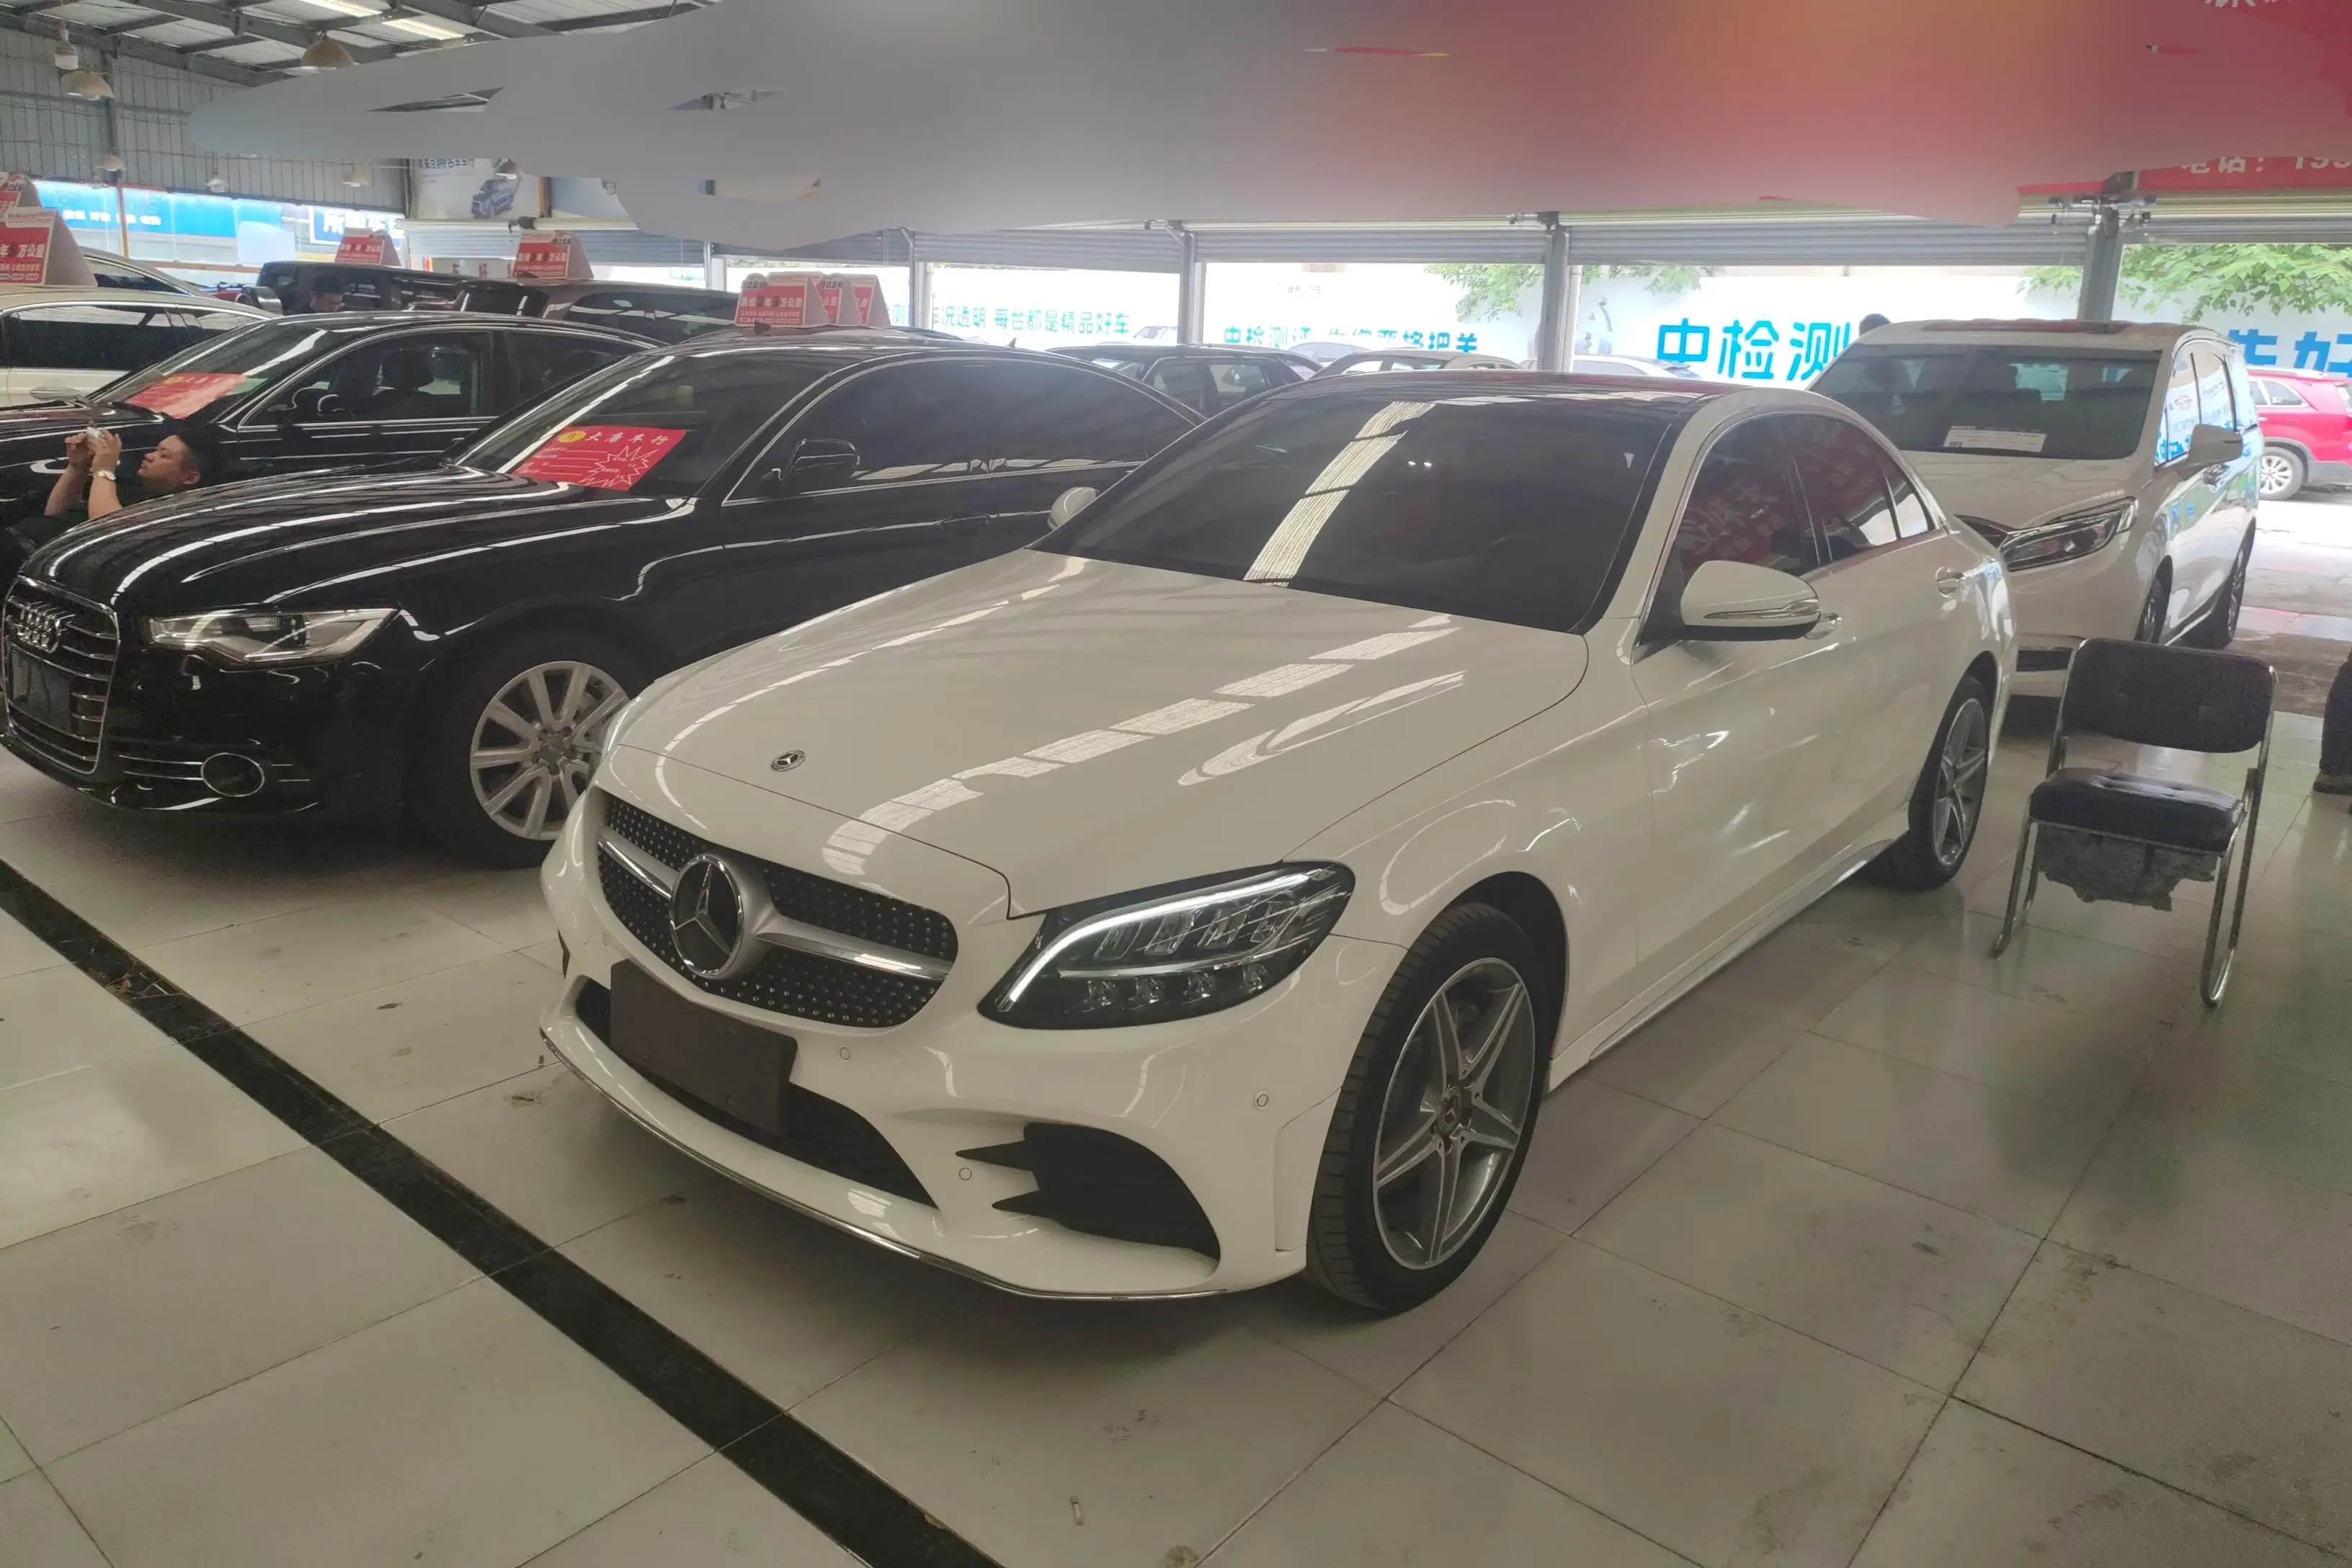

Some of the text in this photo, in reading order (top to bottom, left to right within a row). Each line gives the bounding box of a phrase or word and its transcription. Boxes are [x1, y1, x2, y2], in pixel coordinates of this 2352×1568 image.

[994, 307, 1130, 334] 每台都是精品好车
[1657, 317, 1850, 381] 中检测
